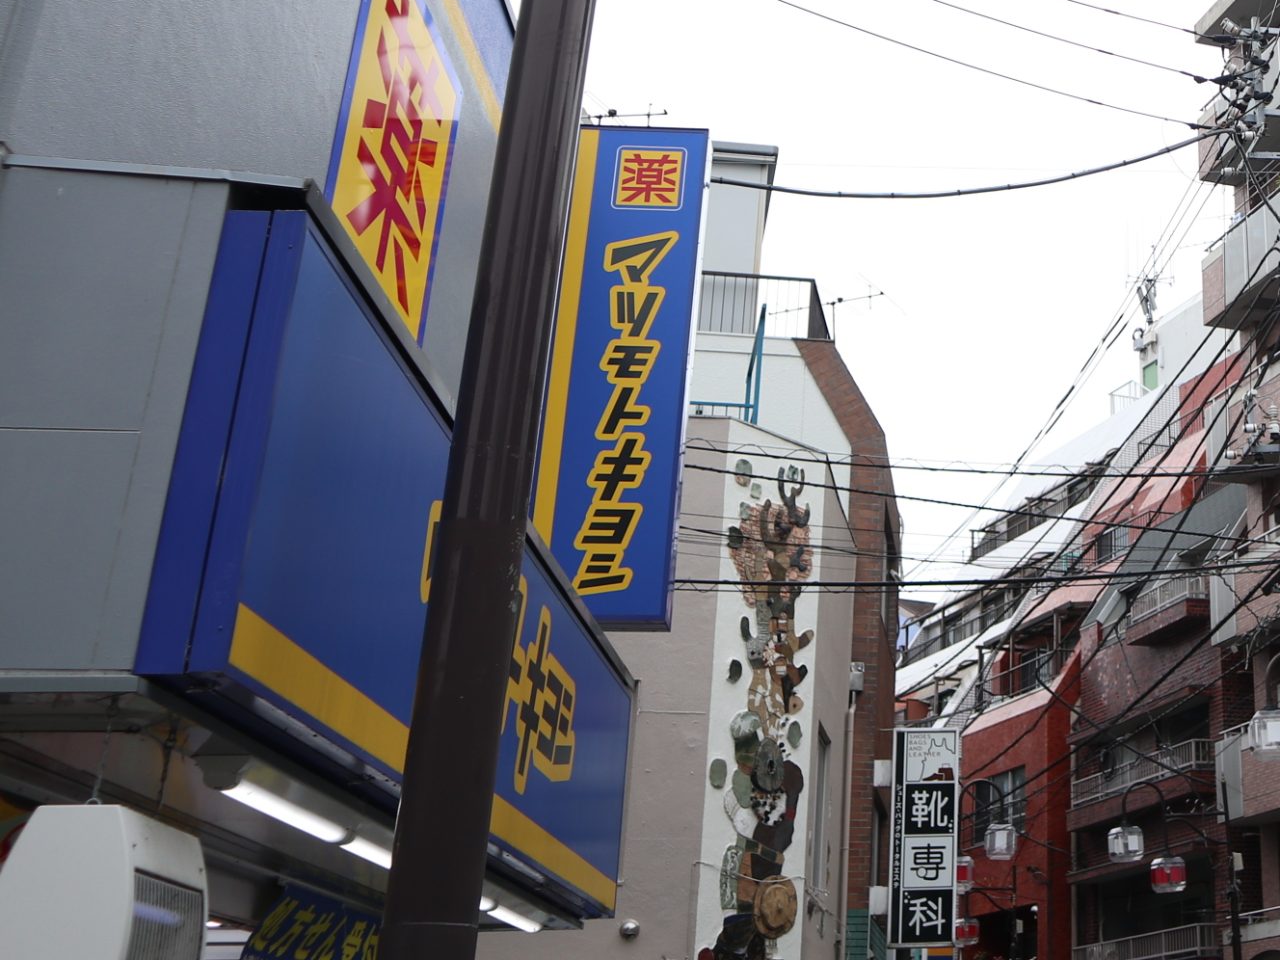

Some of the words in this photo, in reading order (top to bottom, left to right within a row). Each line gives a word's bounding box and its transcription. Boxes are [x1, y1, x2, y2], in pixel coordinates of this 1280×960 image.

[620, 153, 678, 203] 薬
[574, 232, 679, 595] マツモトキヨシ
[909, 790, 949, 936] 靴専科
